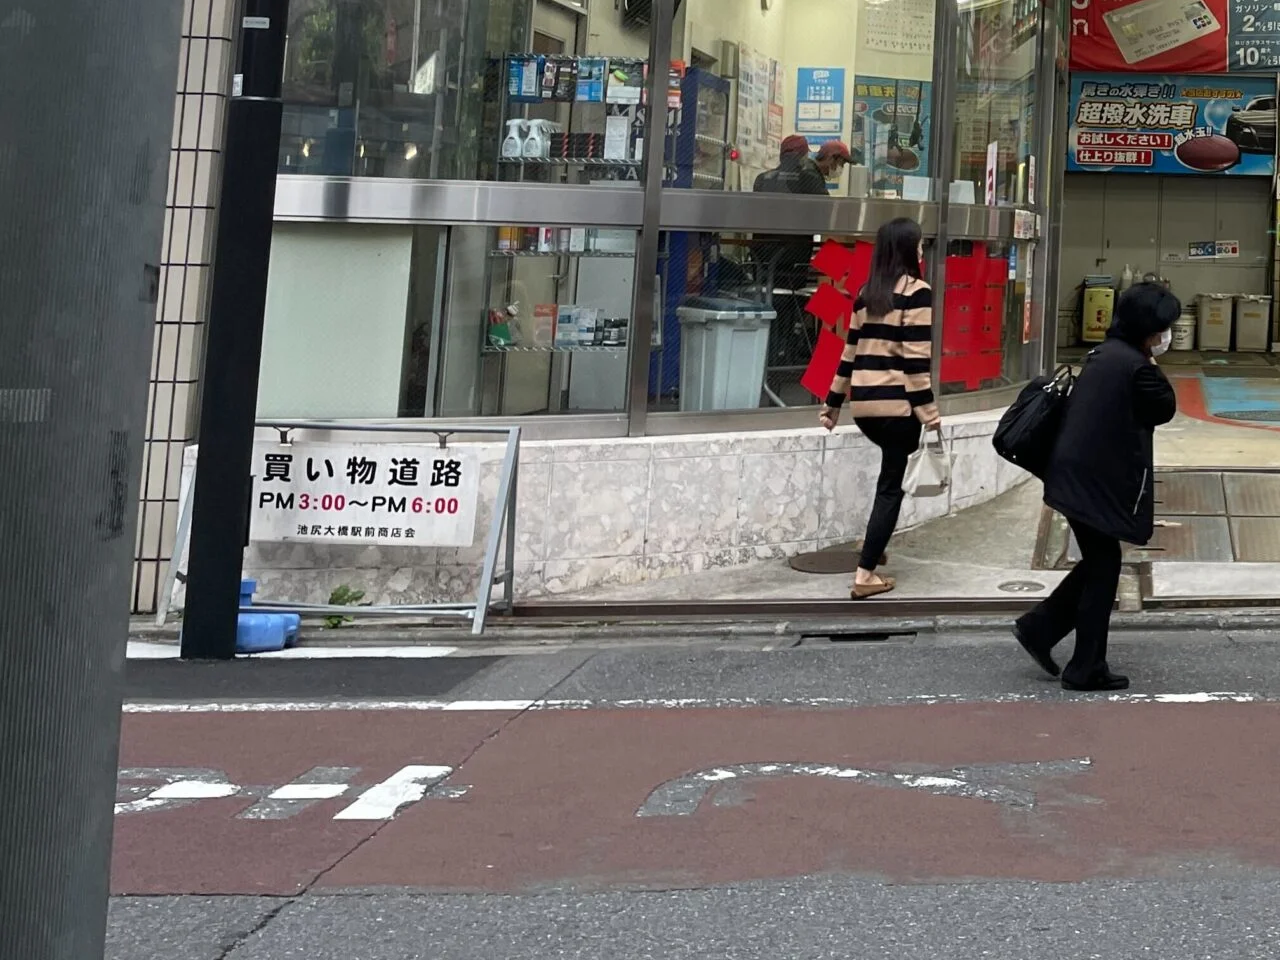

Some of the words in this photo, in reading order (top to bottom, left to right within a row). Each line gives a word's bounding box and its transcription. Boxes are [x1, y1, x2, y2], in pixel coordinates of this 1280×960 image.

[1077, 101, 1197, 127] 超撥水洗車
[262, 453, 462, 488] 買い物道路
[297, 524, 416, 539] 池尻大橋駅前商店会
